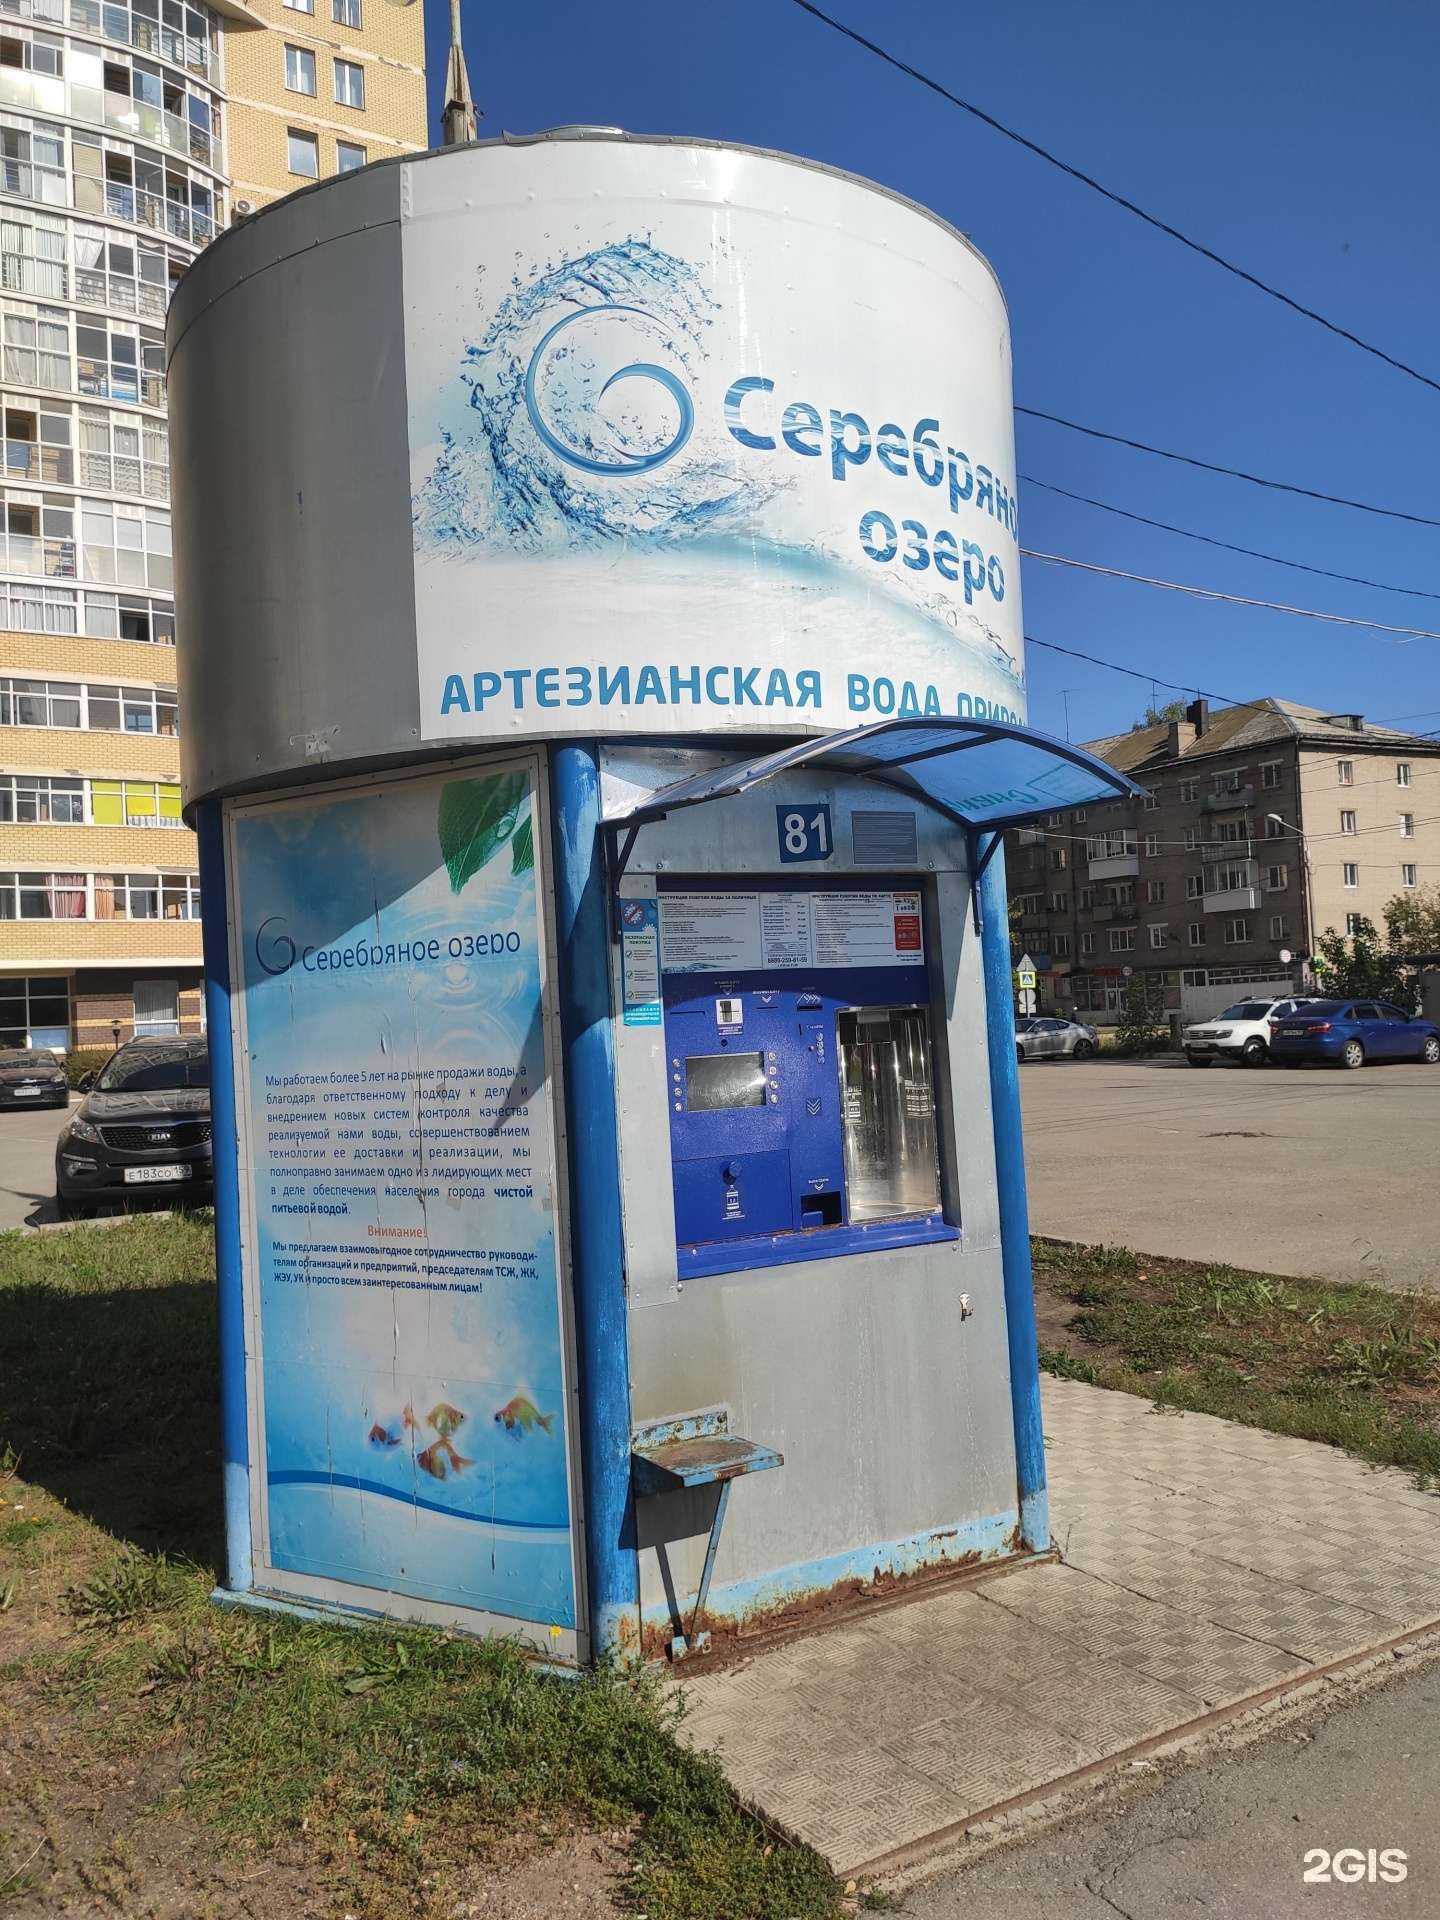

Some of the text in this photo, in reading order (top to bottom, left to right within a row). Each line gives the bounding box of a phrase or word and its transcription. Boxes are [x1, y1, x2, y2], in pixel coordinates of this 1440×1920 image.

[859, 511, 1005, 604] озеро
[441, 665, 822, 714] АРТЕЗИАНСКАЯ
[847, 674, 941, 717] ВОДА
[784, 812, 828, 854] 81
[302, 931, 521, 971] Серебряное озеро
[266, 1066, 527, 1087] Мы работаем более 5 лет на рынке продажи воды, а
[266, 1086, 528, 1105] благодаря ответственному подходу к делу и
[267, 1106, 529, 1124] внедрением новых систем контроля качества
[151, 1133, 167, 1141] KIA
[268, 1127, 530, 1142] реализуемой нами воды, совершенствованием
[269, 1146, 531, 1161] технологии ее доставки и реализации, мы
[270, 1167, 532, 1180] полноправно занимаем одно из лидирующих мест
[271, 1184, 533, 1199] в деле обеспечения населения города чистой
[271, 1202, 351, 1216] питьевой водой.
[367, 1224, 428, 1239] Внимание!
[272, 1241, 538, 1262] Мы предлагаем взаимовыгодное сотрудничество руководи-
[273, 1259, 297, 1267] телям
[298, 1259, 352, 1270] организаций
[360, 1262, 420, 1275] предприятий,
[422, 1265, 494, 1277] председателям
[495, 1266, 519, 1280] ТСЖ,
[520, 1267, 540, 1280] ЖК,
[274, 1272, 483, 1294] ЖЭУ, УК и просто всем заинтересованным лицам!
